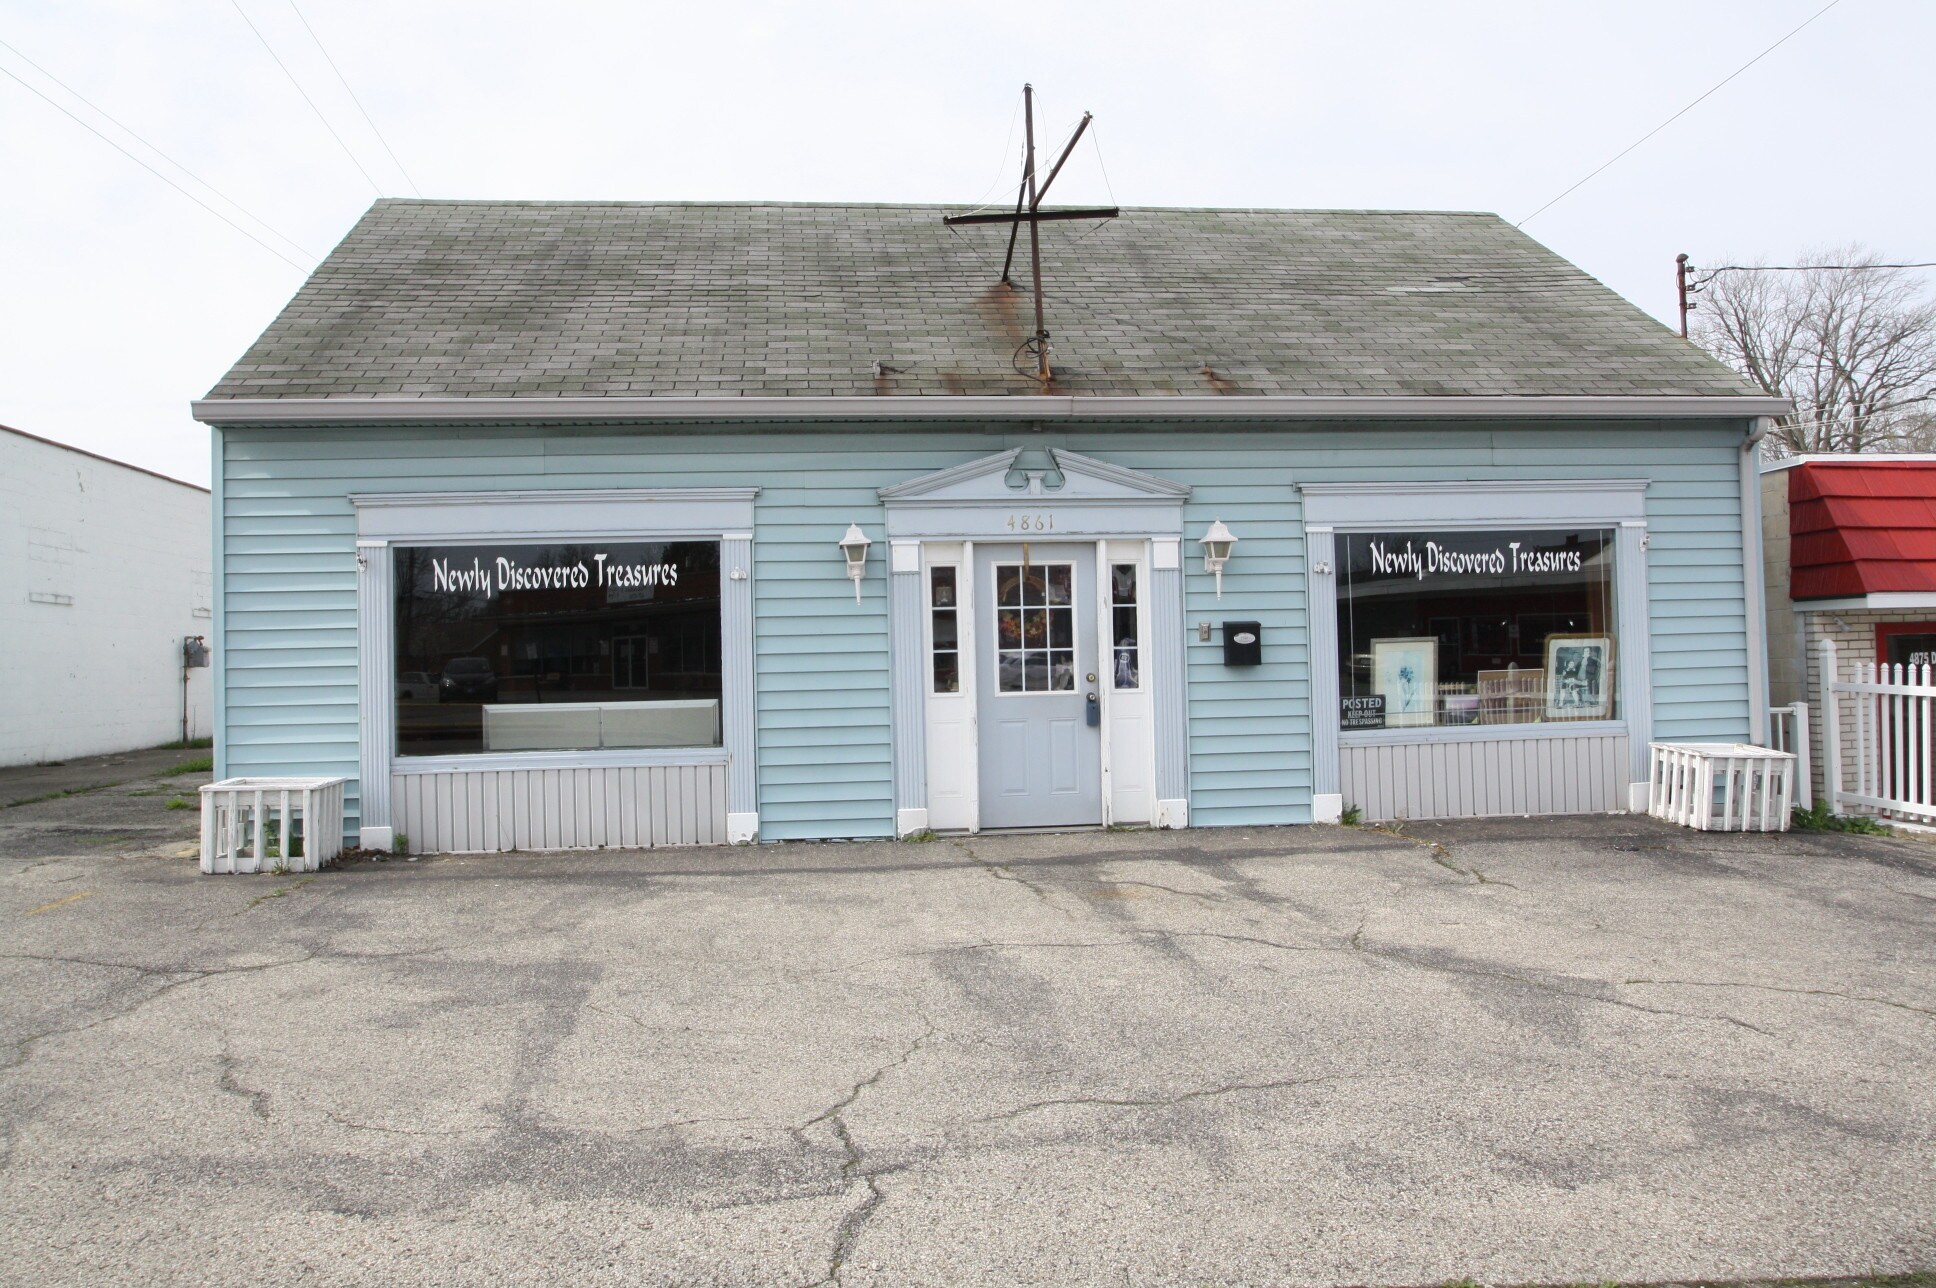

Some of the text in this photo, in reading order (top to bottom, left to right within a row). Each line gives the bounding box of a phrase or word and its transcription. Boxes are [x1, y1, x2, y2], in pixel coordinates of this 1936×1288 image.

[1007, 514, 1054, 531] 4861
[1369, 541, 1581, 581] Newly Discovered Treasures
[432, 553, 678, 599] Newly Discovered Treasures
[1909, 652, 1929, 665] 4875
[1342, 698, 1382, 709] POSTED
[1347, 710, 1376, 718] KEEP OUT
[1349, 717, 1382, 726] TRESPASSING
